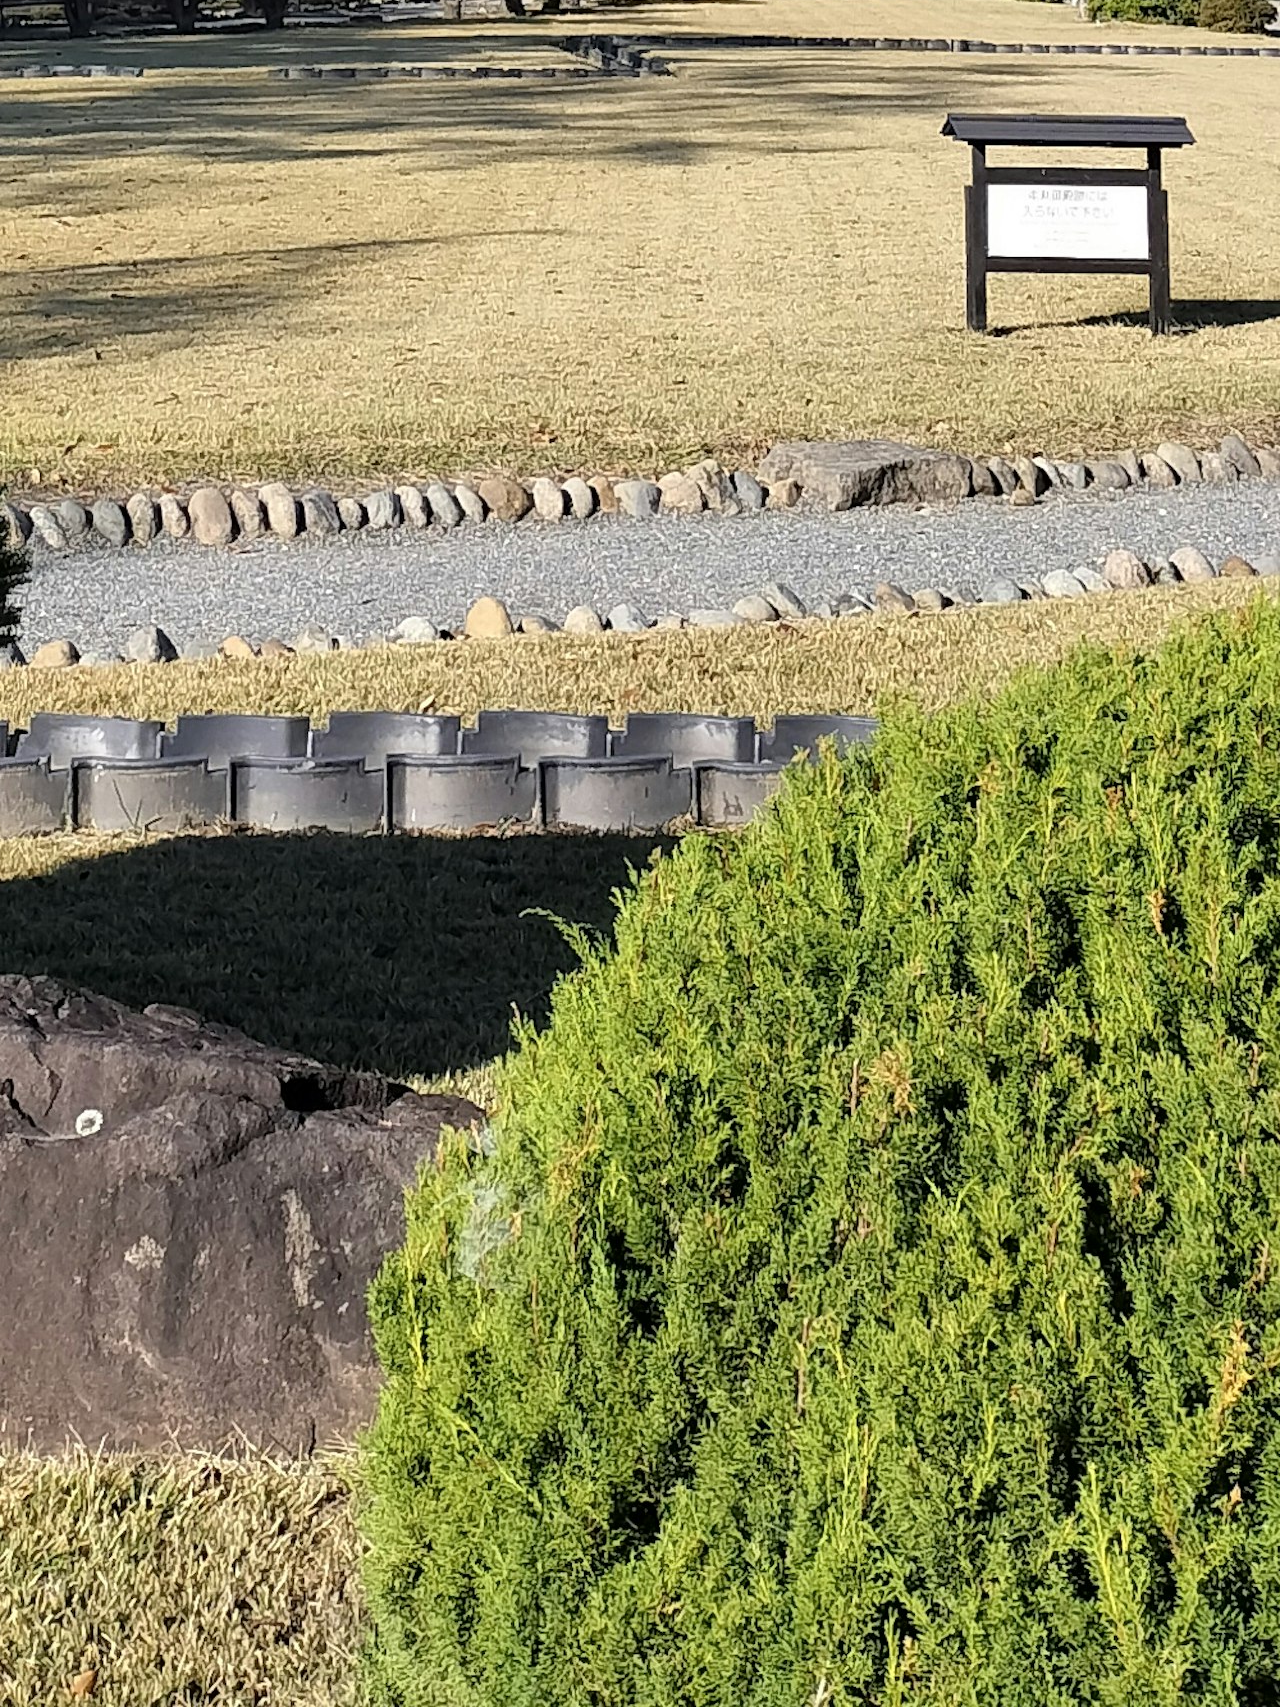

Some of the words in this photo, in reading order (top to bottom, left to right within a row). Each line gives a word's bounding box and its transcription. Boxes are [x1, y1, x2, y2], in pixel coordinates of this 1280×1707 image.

[1023, 205, 1115, 219] 入らないで下さい
